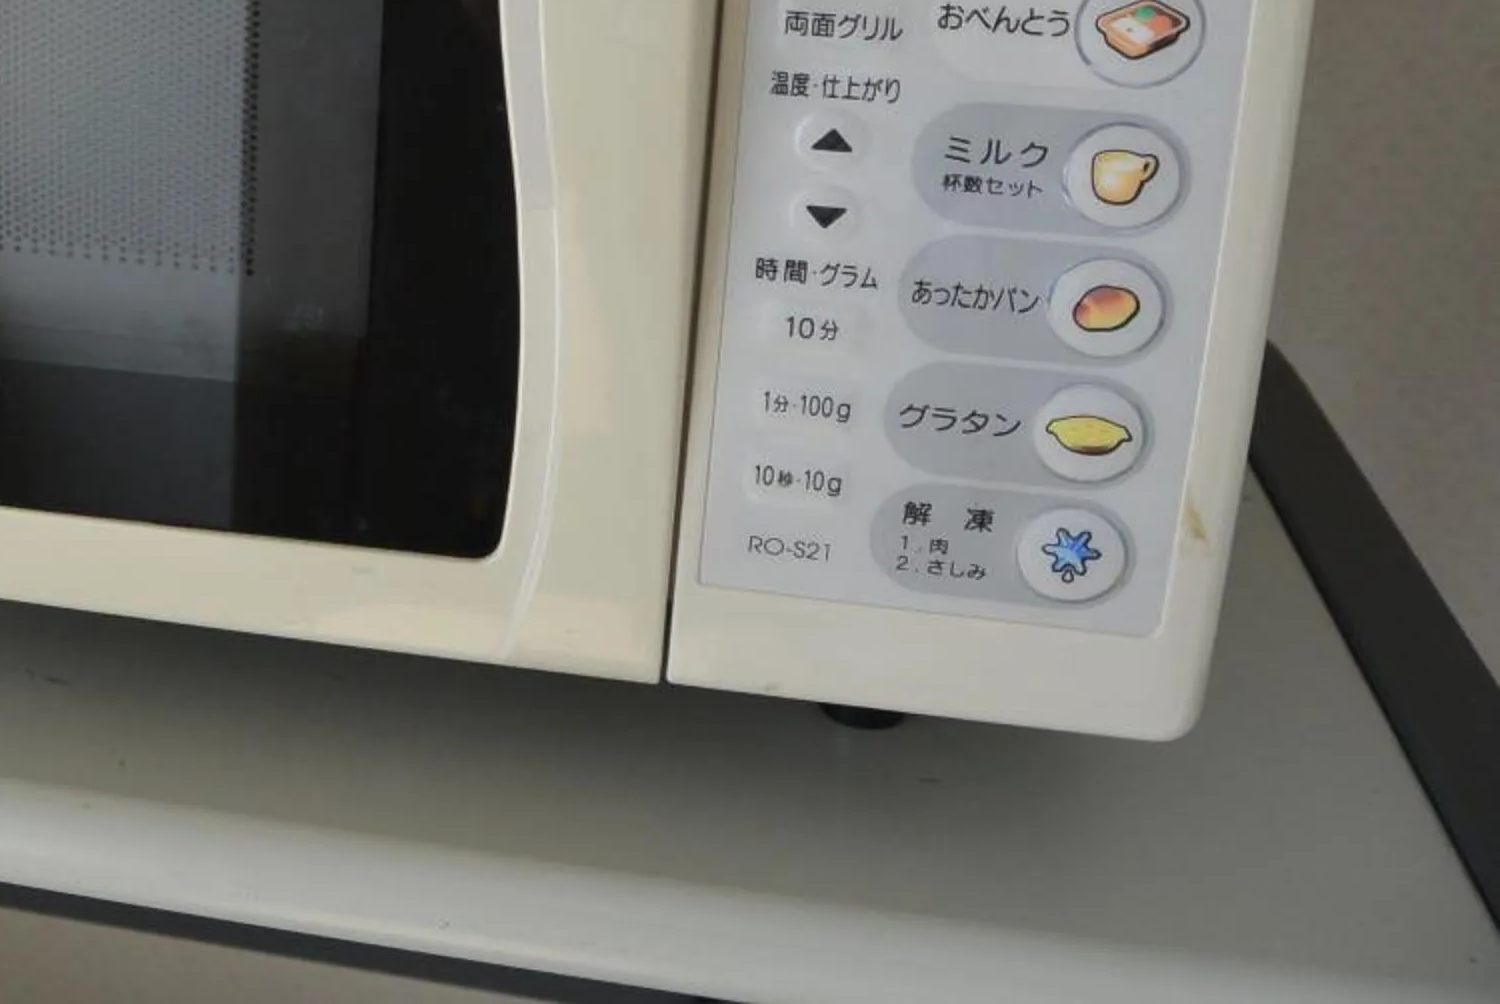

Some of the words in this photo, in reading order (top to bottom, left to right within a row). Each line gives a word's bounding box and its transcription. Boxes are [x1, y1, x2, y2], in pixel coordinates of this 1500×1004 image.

[784, 9, 903, 41] 両面グリル
[937, 3, 1071, 37] おべんとう
[944, 136, 1049, 168] ミルク
[943, 173, 1044, 198] 杯数セット
[786, 316, 840, 341] 10分
[900, 403, 1021, 437] グラタン
[748, 536, 831, 562] RO-S21
